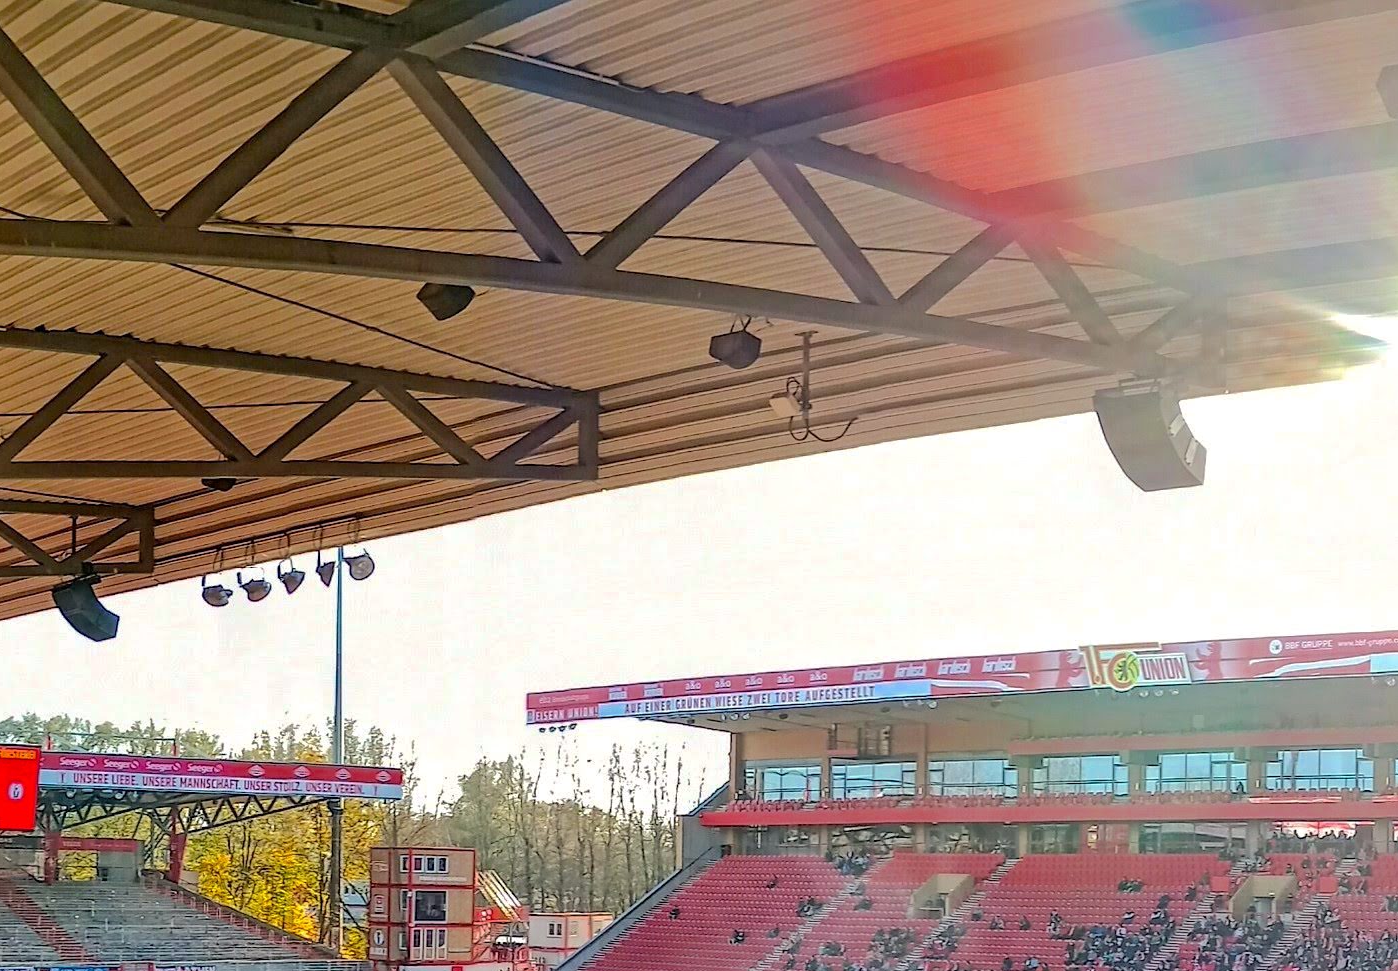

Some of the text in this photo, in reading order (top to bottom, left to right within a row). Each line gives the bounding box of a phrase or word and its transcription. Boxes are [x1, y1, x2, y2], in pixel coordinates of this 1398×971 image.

[1284, 639, 1333, 650] BBF GRUPPE
[1140, 656, 1186, 681] UNION
[626, 685, 875, 714] AUF EINER GRÜNEN WIESE ZWEI TORE AUFGESTELLT
[536, 706, 598, 721] EISERN UNION!
[59, 756, 89, 767] Seeger
[104, 759, 131, 770] Seeger
[145, 761, 173, 772] Seeger
[187, 763, 214, 774] Seeger
[73, 773, 109, 784] UNSERE
[111, 775, 138, 786] LIEBE.
[142, 777, 177, 788] UNSERE
[180, 778, 241, 790] MANNSCHAFT.
[243, 780, 271, 792] UNSER
[305, 783, 331, 794] UNSER
[334, 784, 365, 796] VEREIN.
